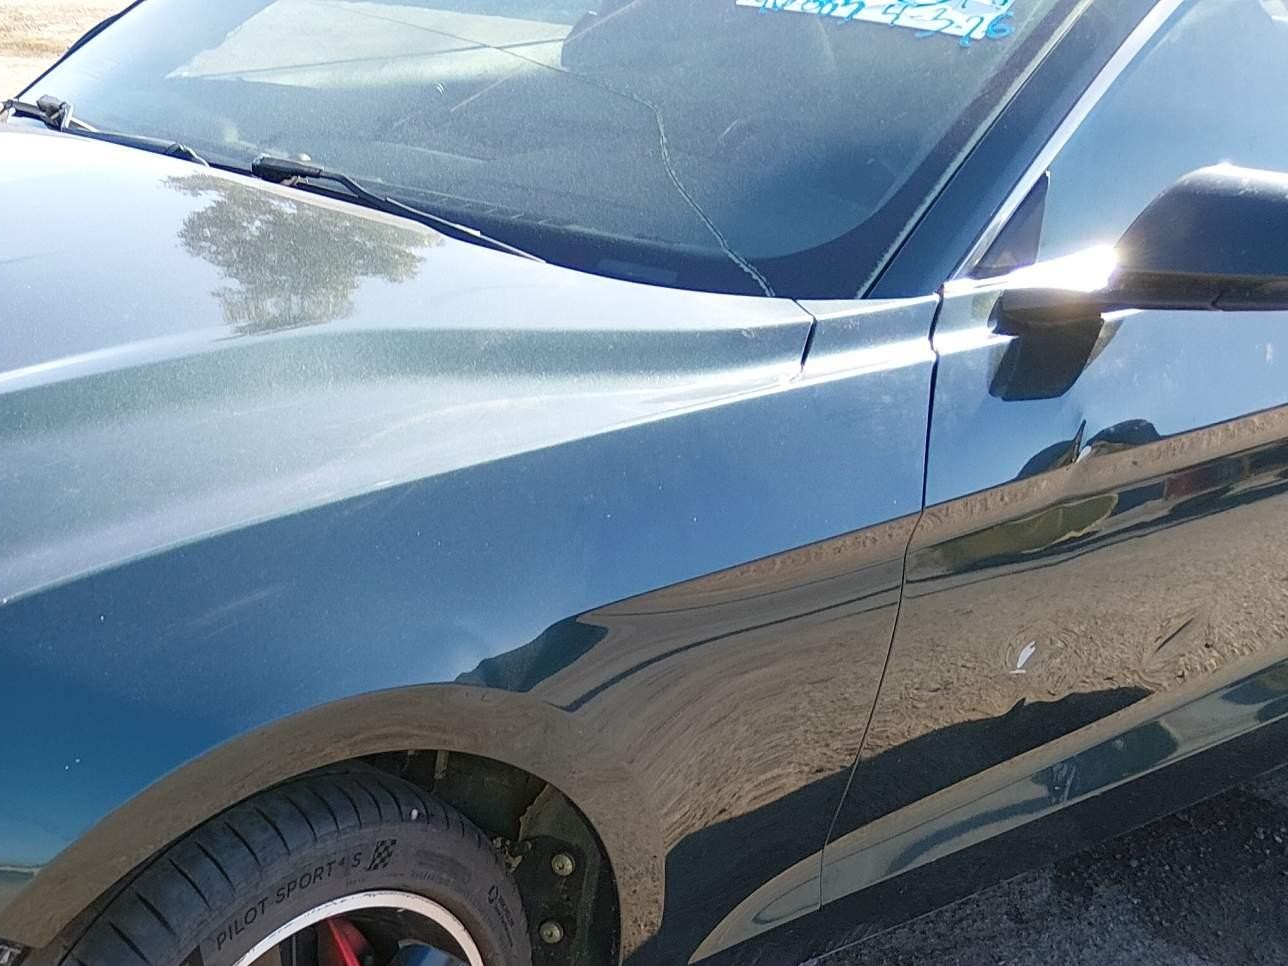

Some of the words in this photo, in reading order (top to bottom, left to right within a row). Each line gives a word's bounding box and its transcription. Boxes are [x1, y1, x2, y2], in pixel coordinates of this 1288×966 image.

[215, 899, 273, 951] PILOT
[275, 859, 337, 903] SPORT
[351, 851, 363, 868] S
